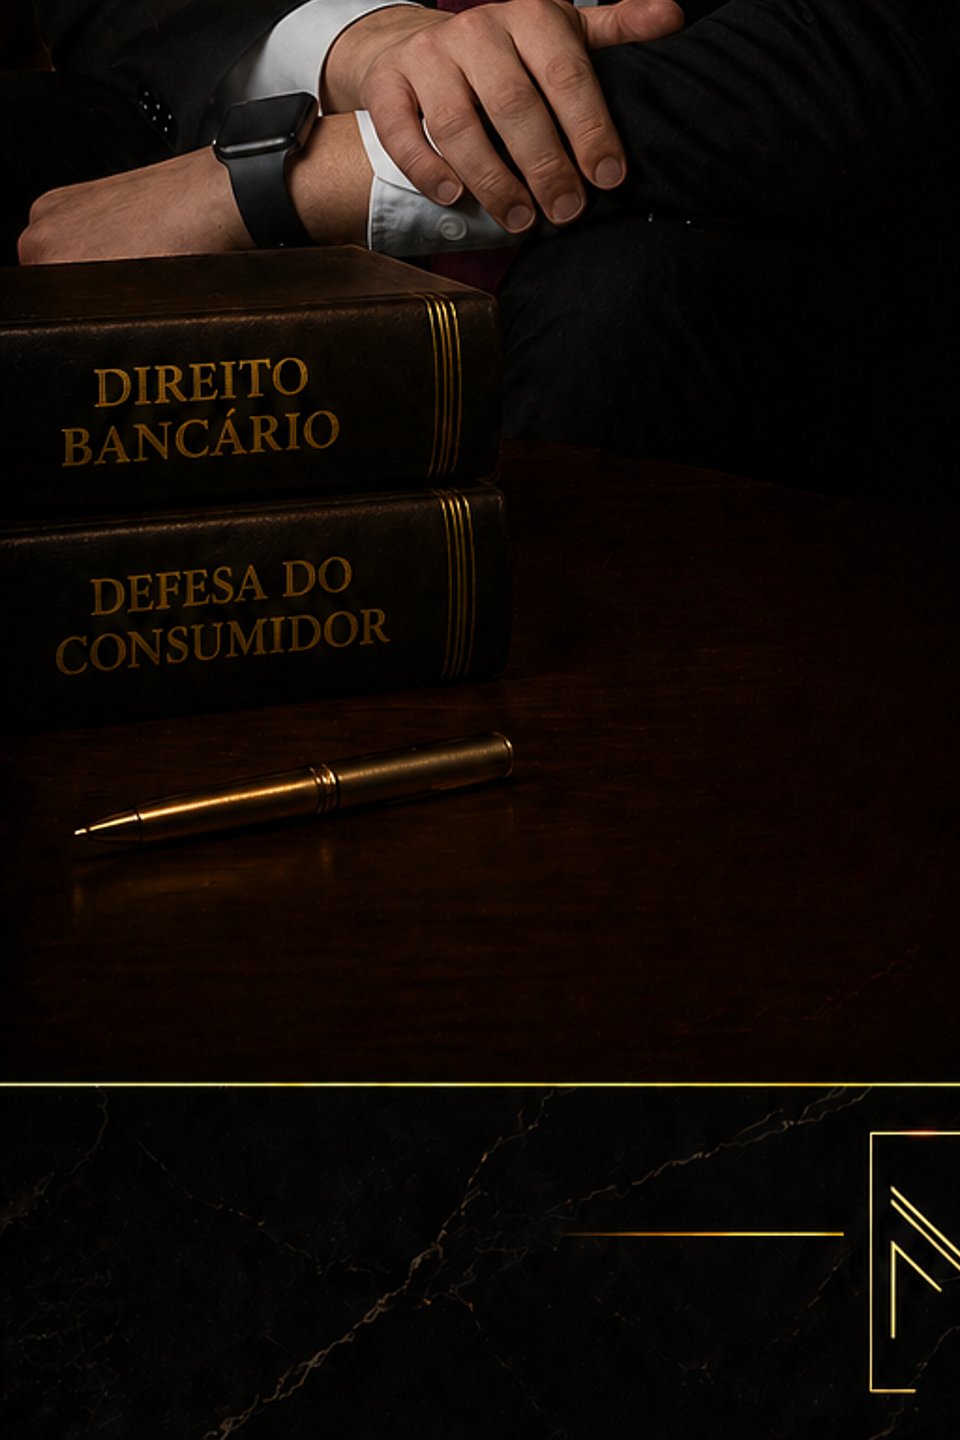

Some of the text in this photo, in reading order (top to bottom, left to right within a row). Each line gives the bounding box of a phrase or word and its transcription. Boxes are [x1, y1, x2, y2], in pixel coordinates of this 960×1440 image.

[93, 358, 309, 408] DIREITO
[61, 408, 340, 467] BANCÁRIO
[89, 556, 353, 616] DEFESA DO
[55, 608, 391, 676] CONSUMIDOR
